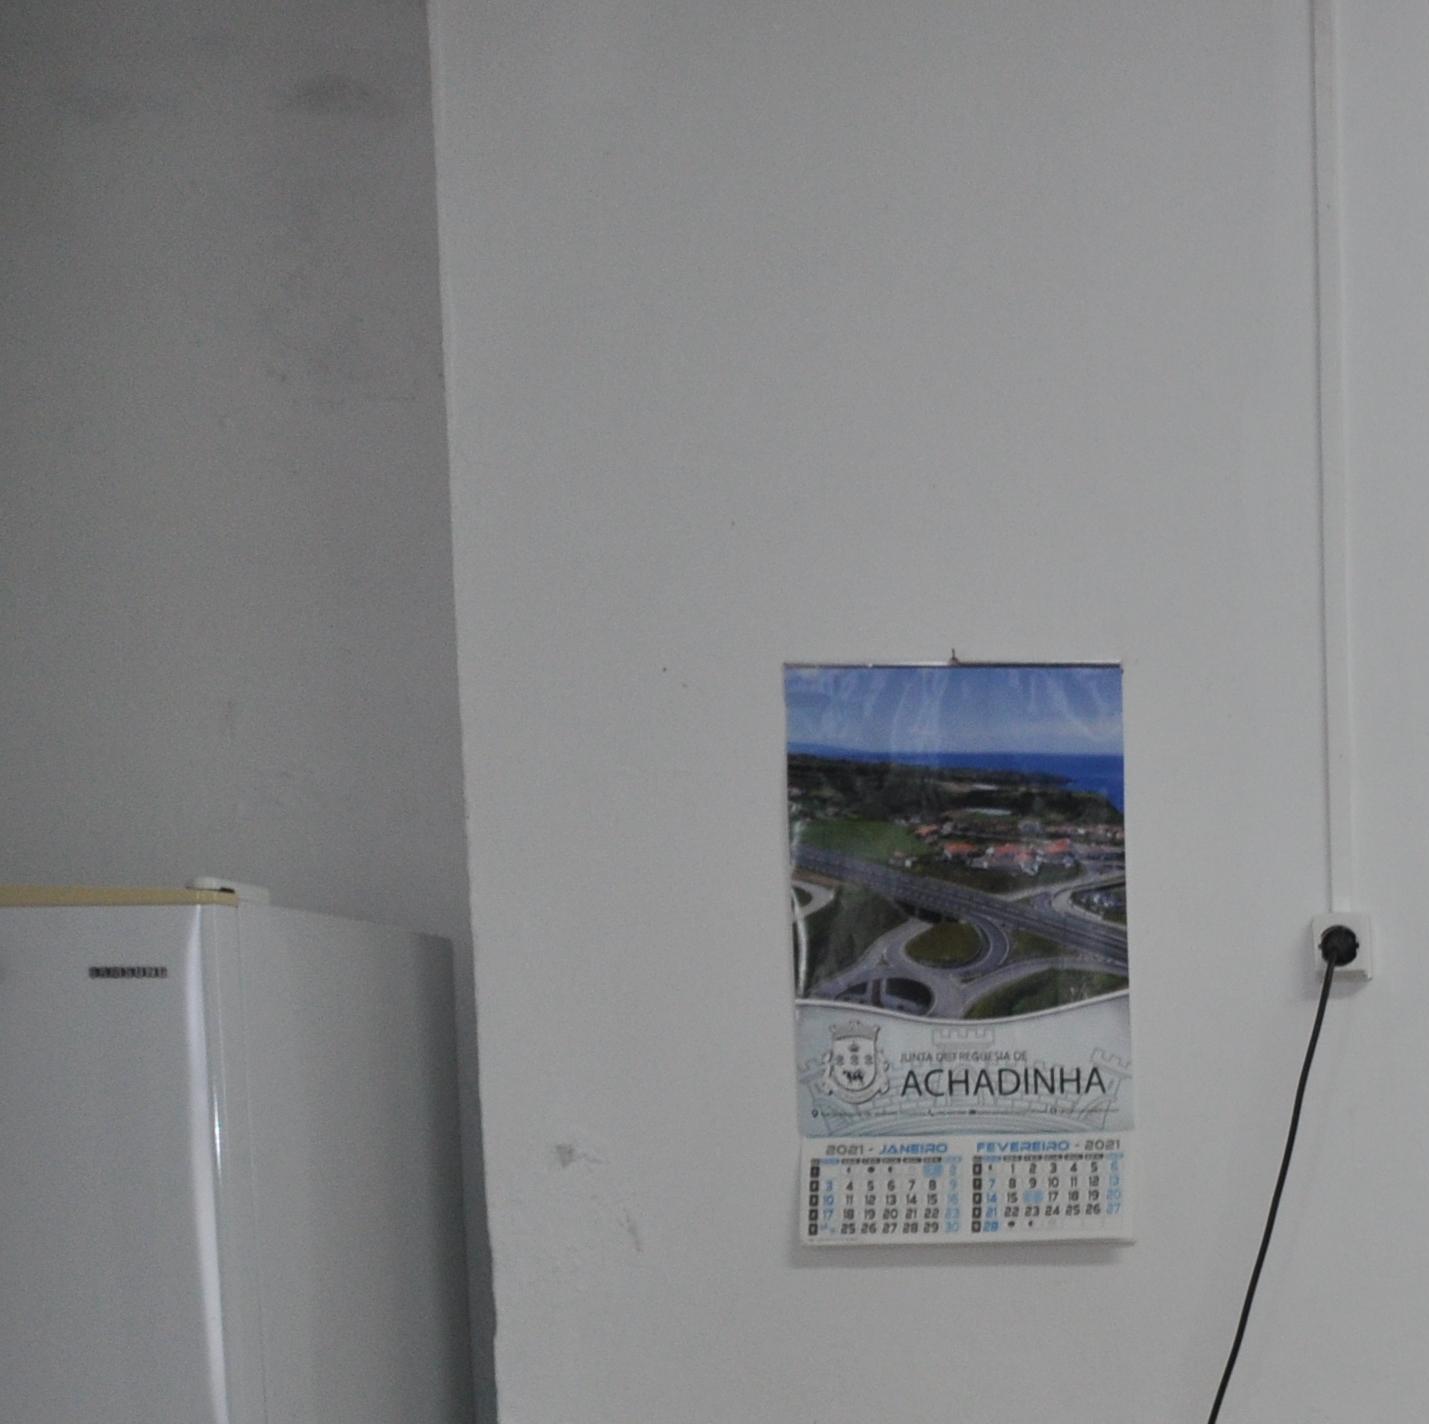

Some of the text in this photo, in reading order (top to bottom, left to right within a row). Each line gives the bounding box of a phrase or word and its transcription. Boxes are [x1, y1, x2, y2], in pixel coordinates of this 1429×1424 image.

[900, 1067, 1106, 1098] ACHADINHA
[826, 1143, 948, 1155] 2021 JANEIRO
[976, 1139, 1121, 1152] FEVEREIRO 2021
[1029, 1163, 1037, 1174] 2
[1050, 1163, 1057, 1174] 3
[1070, 1162, 1077, 1173] 4
[1090, 1162, 1098, 1173] 5
[845, 1181, 854, 1191] 4
[867, 1180, 874, 1191] 5
[887, 1180, 895, 1191] 6
[908, 1179, 916, 1190] 7
[928, 1179, 937, 1191] 8
[1008, 1178, 1017, 1189] 8
[1029, 1178, 1037, 1189] 9
[1049, 1177, 1059, 1188] 10
[1070, 1176, 1077, 1187] 11
[1089, 1176, 1099, 1187] 12
[846, 1195, 854, 1205] 11
[865, 1195, 876, 1205] 12
[885, 1195, 897, 1205] 13
[906, 1194, 917, 1205] 14
[927, 1194, 938, 1205] 15
[1007, 1193, 1018, 1204] 15
[1049, 1191, 1059, 1202] 17
[1068, 1191, 1079, 1201] 18
[1088, 1190, 1099, 1201] 19
[843, 1209, 854, 1220] 18
[864, 1209, 876, 1220] 19
[882, 1209, 898, 1219] 20
[905, 1209, 918, 1219] 21
[924, 1208, 940, 1219] 22
[1004, 1207, 1020, 1217] 22
[1024, 1206, 1040, 1217] 23
[1045, 1205, 1060, 1216] 24
[1065, 1205, 1080, 1216] 25
[1085, 1204, 1101, 1215] 26
[841, 1223, 856, 1234] 25
[861, 1223, 877, 1234] 26
[882, 1222, 898, 1234] 27
[902, 1222, 918, 1233] 28
[923, 1222, 939, 1233] 29
